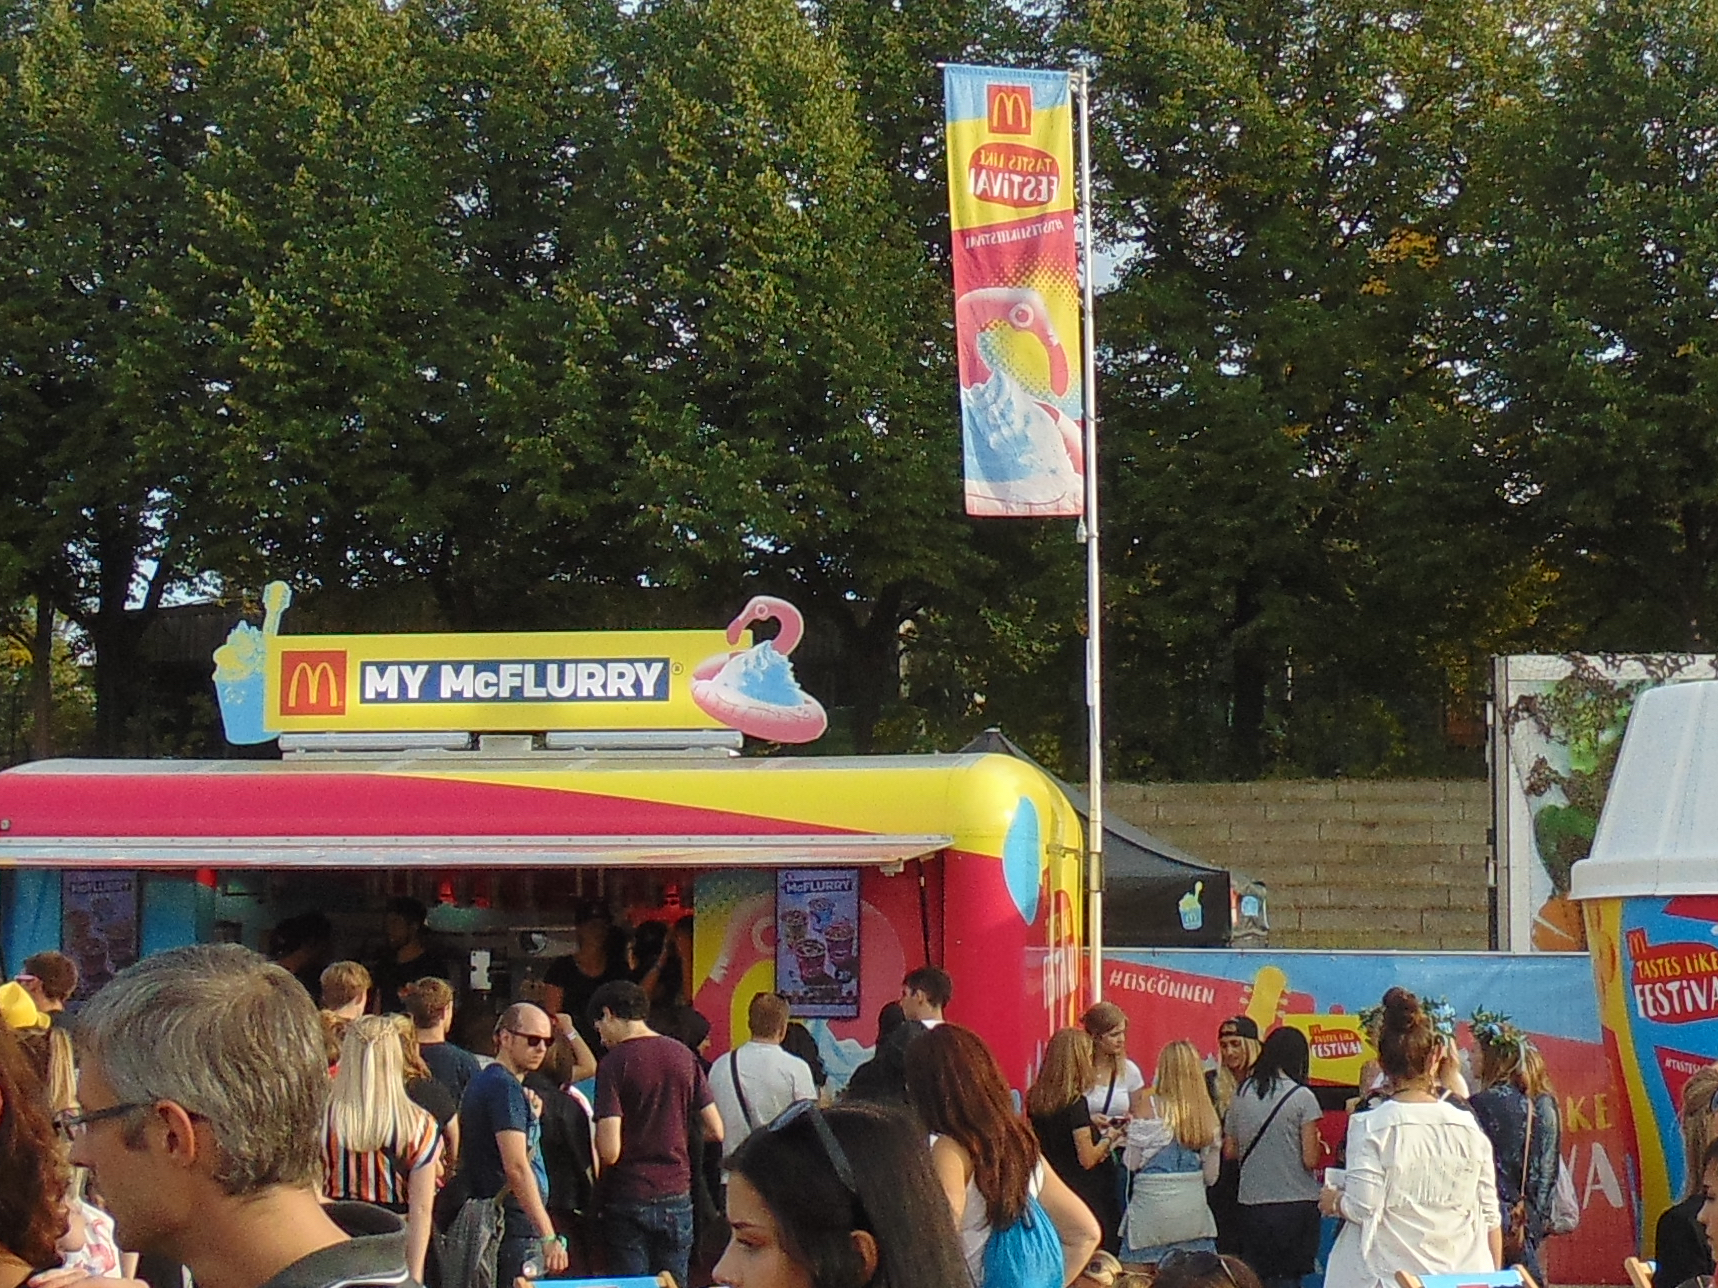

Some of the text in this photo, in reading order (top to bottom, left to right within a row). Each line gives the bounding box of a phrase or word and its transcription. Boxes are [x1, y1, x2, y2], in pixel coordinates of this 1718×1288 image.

[364, 662, 665, 699] MY McFLURRY
[785, 879, 851, 893] McFLURRY
[1635, 956, 1681, 979] TASTES
